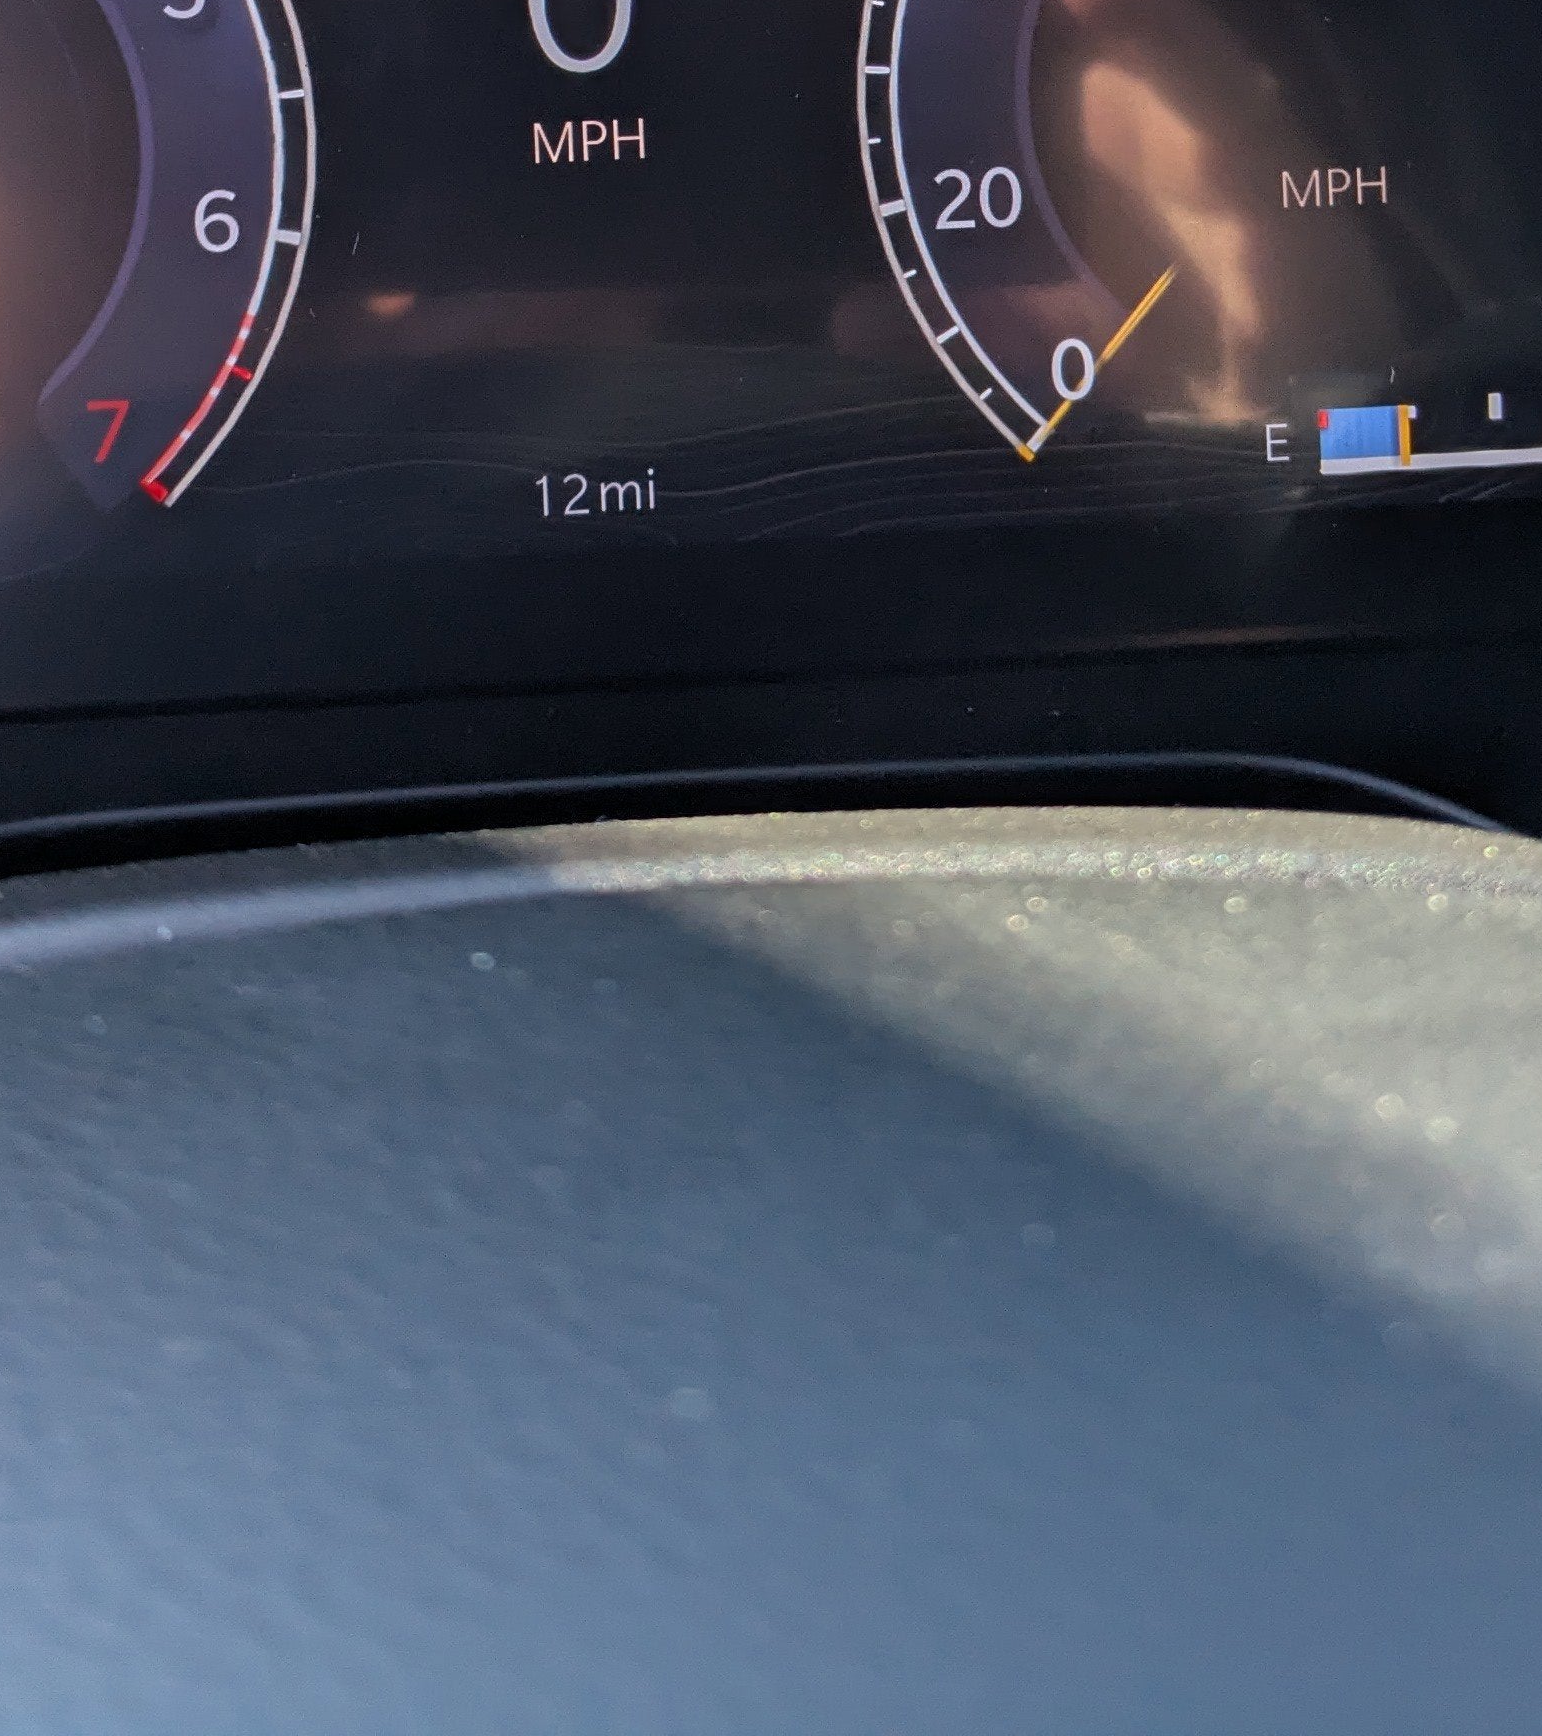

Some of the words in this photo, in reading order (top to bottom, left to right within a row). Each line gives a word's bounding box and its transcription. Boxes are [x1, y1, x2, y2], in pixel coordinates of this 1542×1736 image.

[532, 118, 647, 165] MPH
[932, 165, 1024, 231] 20
[1280, 168, 1389, 209] MPH
[193, 189, 240, 253] 6
[1051, 338, 1095, 399] 0
[85, 399, 130, 464] 7
[1263, 422, 1291, 462] E
[533, 469, 657, 518] 12mi
